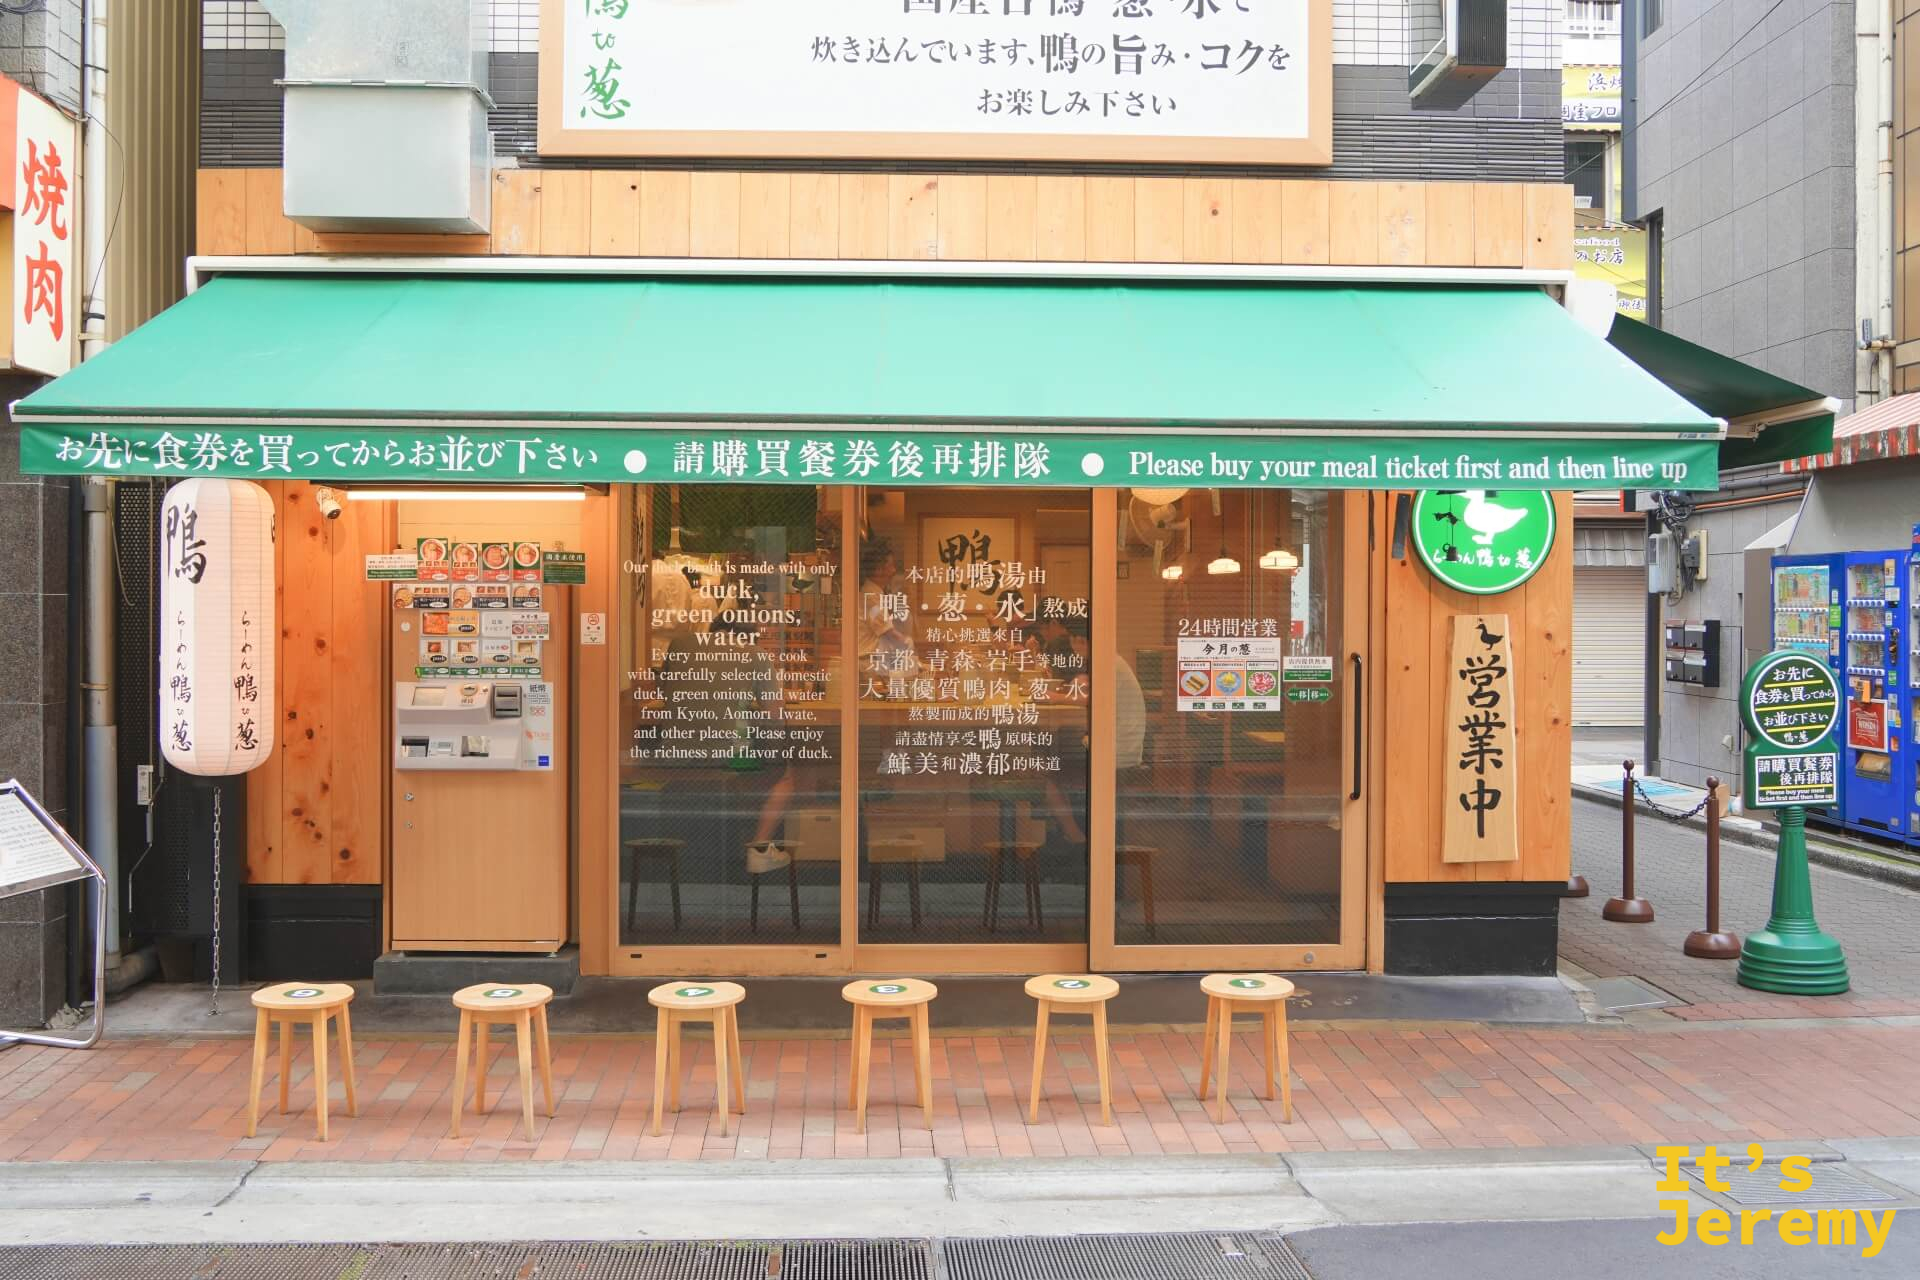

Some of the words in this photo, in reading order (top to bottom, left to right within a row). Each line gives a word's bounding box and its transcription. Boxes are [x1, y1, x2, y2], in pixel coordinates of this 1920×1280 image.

[977, 88, 1177, 117] お楽しみ下さい
[21, 139, 69, 342] 焼肉
[55, 431, 599, 474] お先に食券を買ってからお並び下さい
[672, 440, 1051, 478] 請購買餐券後再排隊
[1129, 451, 1203, 477] Please
[1210, 454, 1252, 483] buy
[1259, 460, 1316, 481] your
[1322, 456, 1378, 479] meal
[1384, 456, 1449, 480] ticket
[1455, 456, 1502, 480] first
[1509, 456, 1550, 480] and
[1557, 456, 1606, 480] then
[1613, 455, 1655, 480] line
[1661, 459, 1687, 483] up
[624, 560, 649, 574] Our
[687, 560, 721, 574] bth
[726, 560, 736, 574] is
[740, 561, 775, 574] made
[779, 561, 806, 575] with
[810, 562, 837, 577] only
[906, 562, 1046, 588] 本店的鴨湯由
[651, 608, 713, 627] green
[722, 603, 801, 627] onions,
[926, 628, 1023, 643] 精心挑選來自
[1178, 618, 1279, 637] 24時間営業
[651, 649, 691, 663] Every
[695, 650, 752, 663] morning,
[757, 653, 775, 661] we
[779, 649, 808, 661] cook
[1202, 643, 1251, 656] 今月の葱
[868, 649, 1083, 672] 京都、青森、岩手等地的
[627, 669, 655, 681] with
[660, 669, 717, 683] carefully
[721, 669, 771, 681] selected
[776, 669, 832, 682] domestic
[1773, 667, 1815, 682] お先に
[634, 688, 668, 701] duck,
[672, 691, 709, 702] green
[713, 688, 756, 701] onions,
[761, 688, 783, 700] and
[788, 690, 825, 701] water
[1755, 687, 1835, 705] 食券を買ってから
[641, 707, 672, 719] from
[677, 707, 718, 721] Kyoto,
[779, 708, 817, 720] Iwate,
[1764, 711, 1829, 727] お並び下さい
[634, 727, 657, 738] and
[661, 727, 693, 739] other
[699, 727, 742, 741] places.
[746, 727, 786, 739] Please
[790, 727, 824, 742] enjoy
[630, 747, 650, 759] the
[654, 747, 707, 759] richness
[711, 747, 734, 759] and
[739, 747, 778, 759] flavor
[782, 747, 795, 759] of
[798, 747, 832, 760] duck.
[1459, 655, 1507, 838] 営業中
[887, 751, 1061, 775] 鮮美和濃郁的味道
[1758, 756, 1833, 773] 請購買餐券
[1780, 771, 1833, 785] 後再排隊
